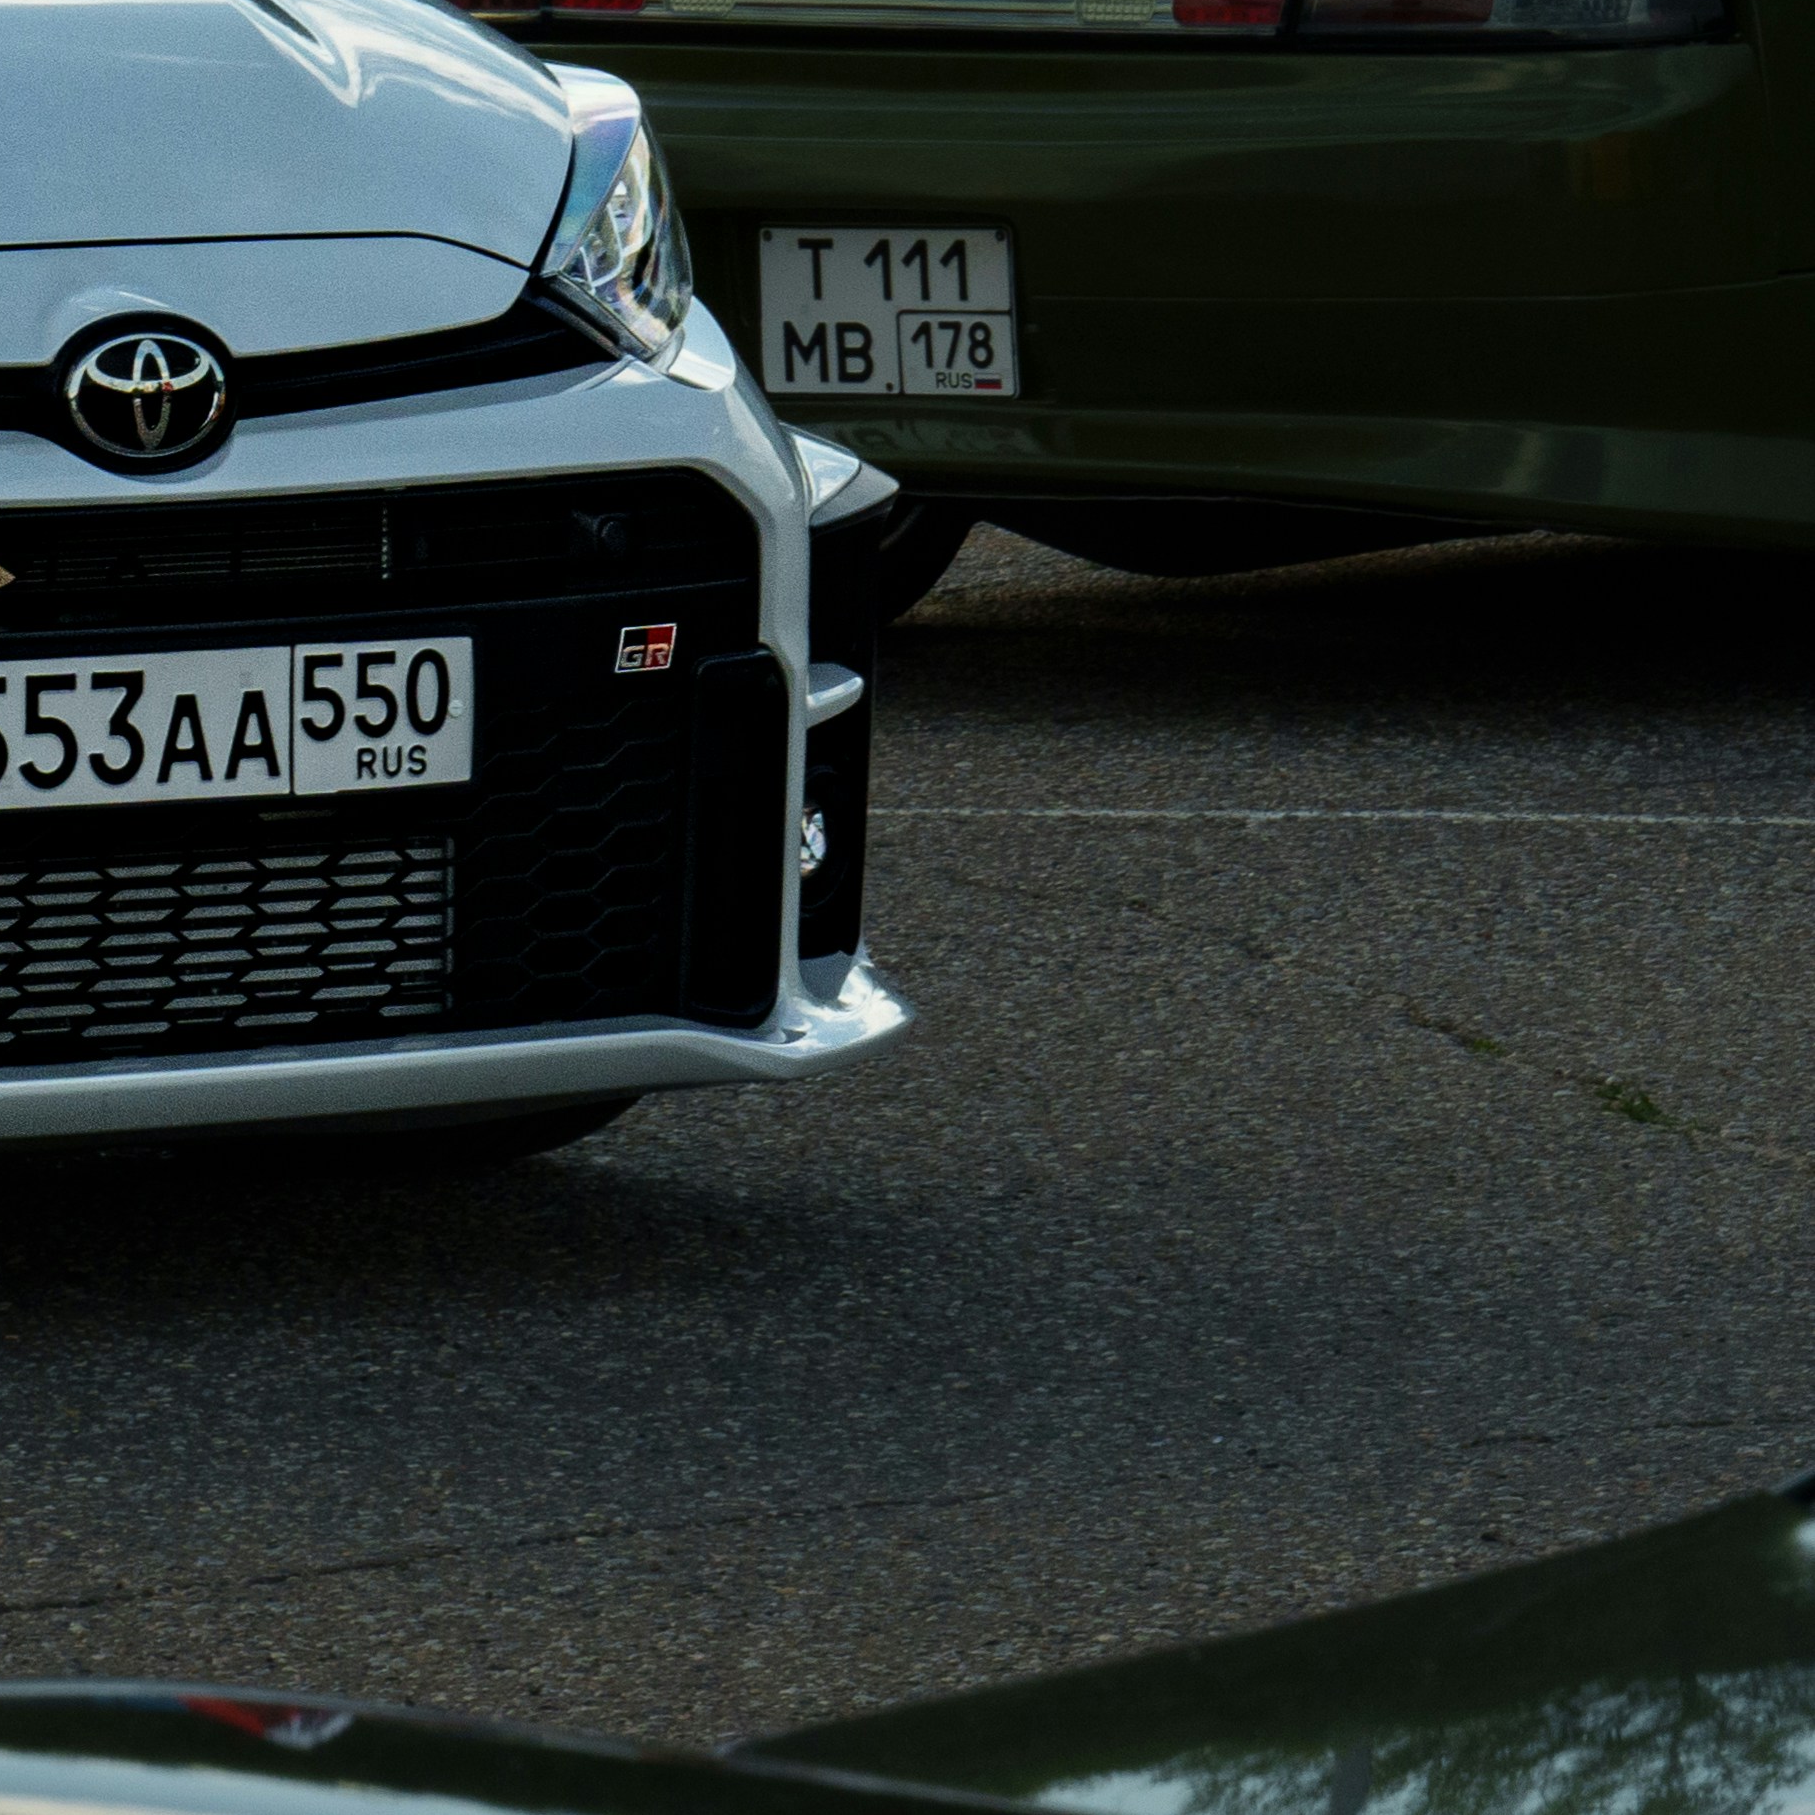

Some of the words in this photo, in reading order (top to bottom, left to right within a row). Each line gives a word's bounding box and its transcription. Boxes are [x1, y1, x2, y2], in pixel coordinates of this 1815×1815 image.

[797, 237, 834, 301] T
[863, 238, 969, 301] 111
[782, 320, 874, 383] MB
[910, 320, 995, 370] 178
[935, 371, 973, 390] RUS
[619, 642, 670, 668] GR
[300, 648, 450, 742] 550
[356, 745, 428, 779] RUS
